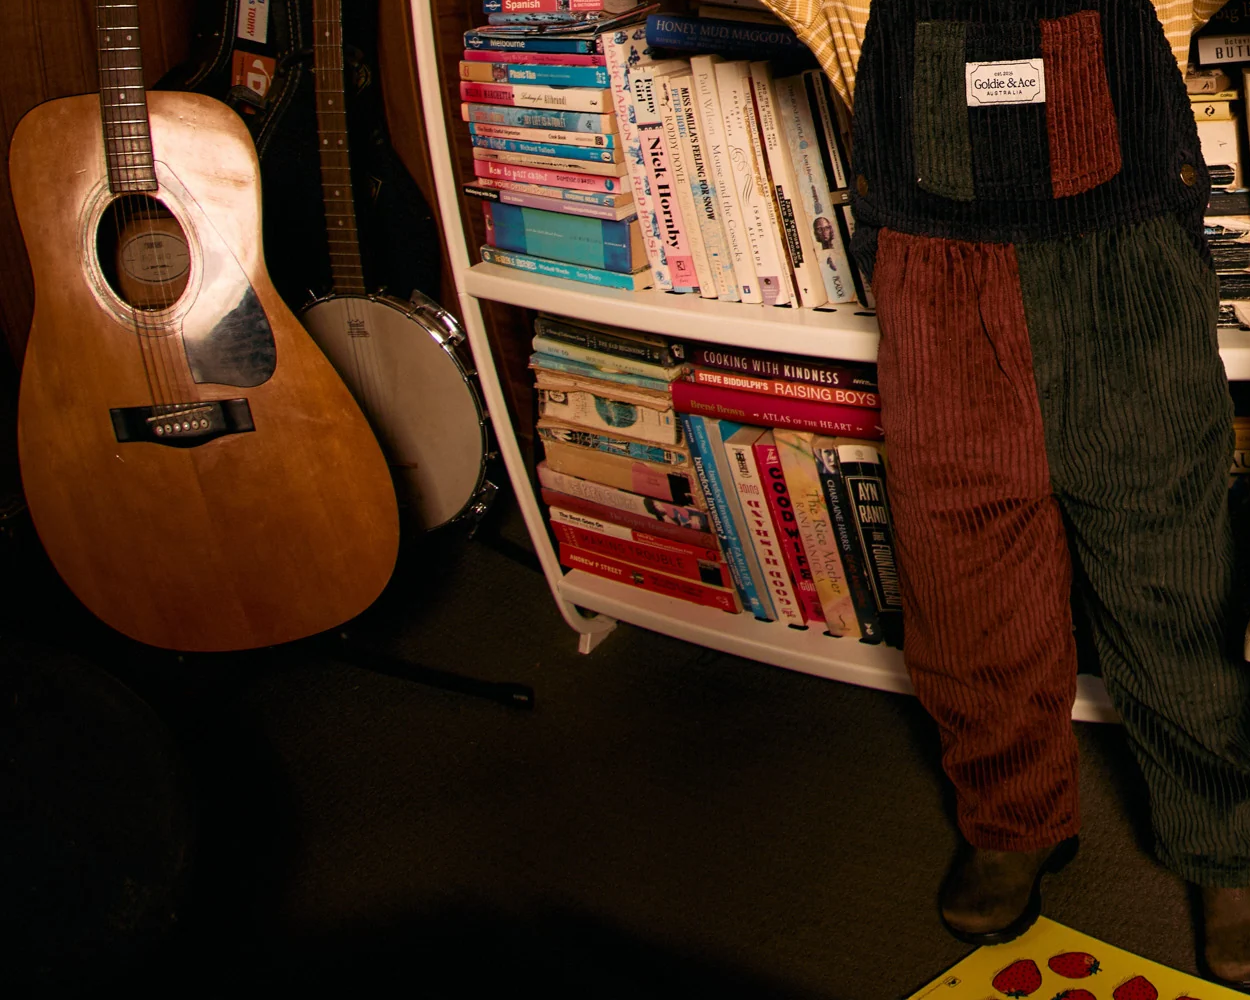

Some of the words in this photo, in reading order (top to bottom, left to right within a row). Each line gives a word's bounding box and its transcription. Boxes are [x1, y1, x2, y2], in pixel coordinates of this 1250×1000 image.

[505, 0, 540, 11] Spanish
[247, 8, 257, 37] TODAY
[490, 38, 525, 48] Melbourne
[634, 79, 645, 103] Girl
[974, 78, 1005, 89] Goldie
[1007, 78, 1017, 88] &
[1018, 78, 1036, 87] Ace
[644, 78, 656, 115] Funny
[665, 115, 677, 150] RODDY
[672, 151, 686, 184] DOYLE
[647, 137, 664, 179] Nick
[657, 184, 680, 251] Hornby
[703, 352, 749, 371] COOKING
[752, 358, 780, 375] WITH
[783, 364, 839, 385] KINDNESS
[699, 372, 722, 386] STEVE
[724, 376, 769, 392] BIDDULPH'S
[774, 382, 833, 401] RAISING
[836, 389, 876, 406] BOYS
[763, 413, 791, 424] ATLAS
[820, 420, 852, 432] HEART
[858, 482, 879, 502] AYN
[860, 504, 887, 524] RAND
